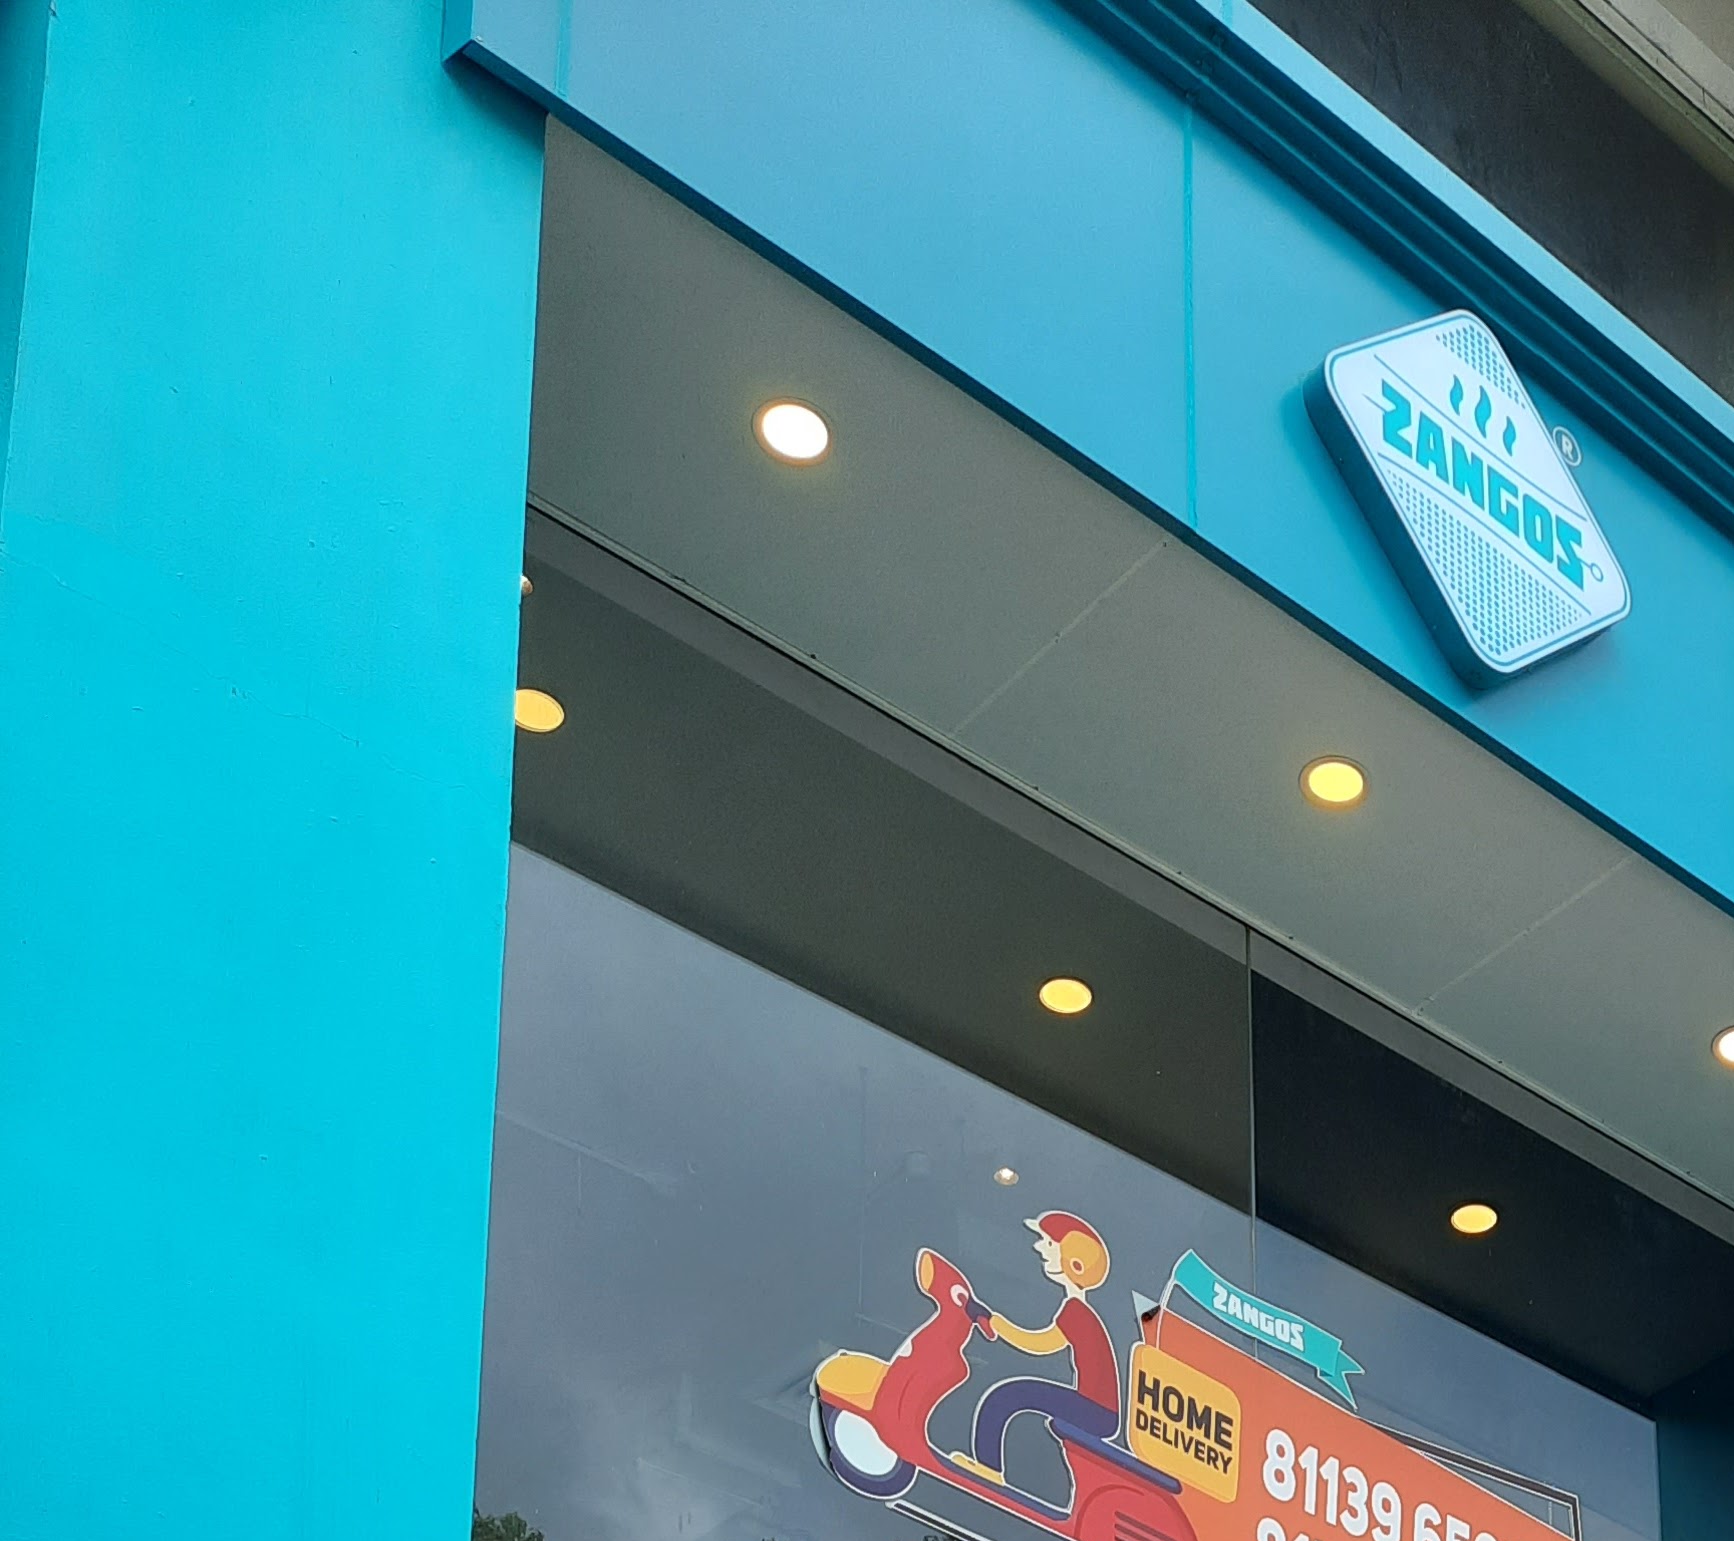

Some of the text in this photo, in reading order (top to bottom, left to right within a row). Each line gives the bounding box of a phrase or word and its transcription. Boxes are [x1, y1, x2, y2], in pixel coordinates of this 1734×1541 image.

[1380, 377, 1586, 592] ZANGOS
[1211, 1282, 1305, 1352] ZANGOS
[1135, 1413, 1233, 1475] DELIVERY
[1137, 1370, 1235, 1451] HOME
